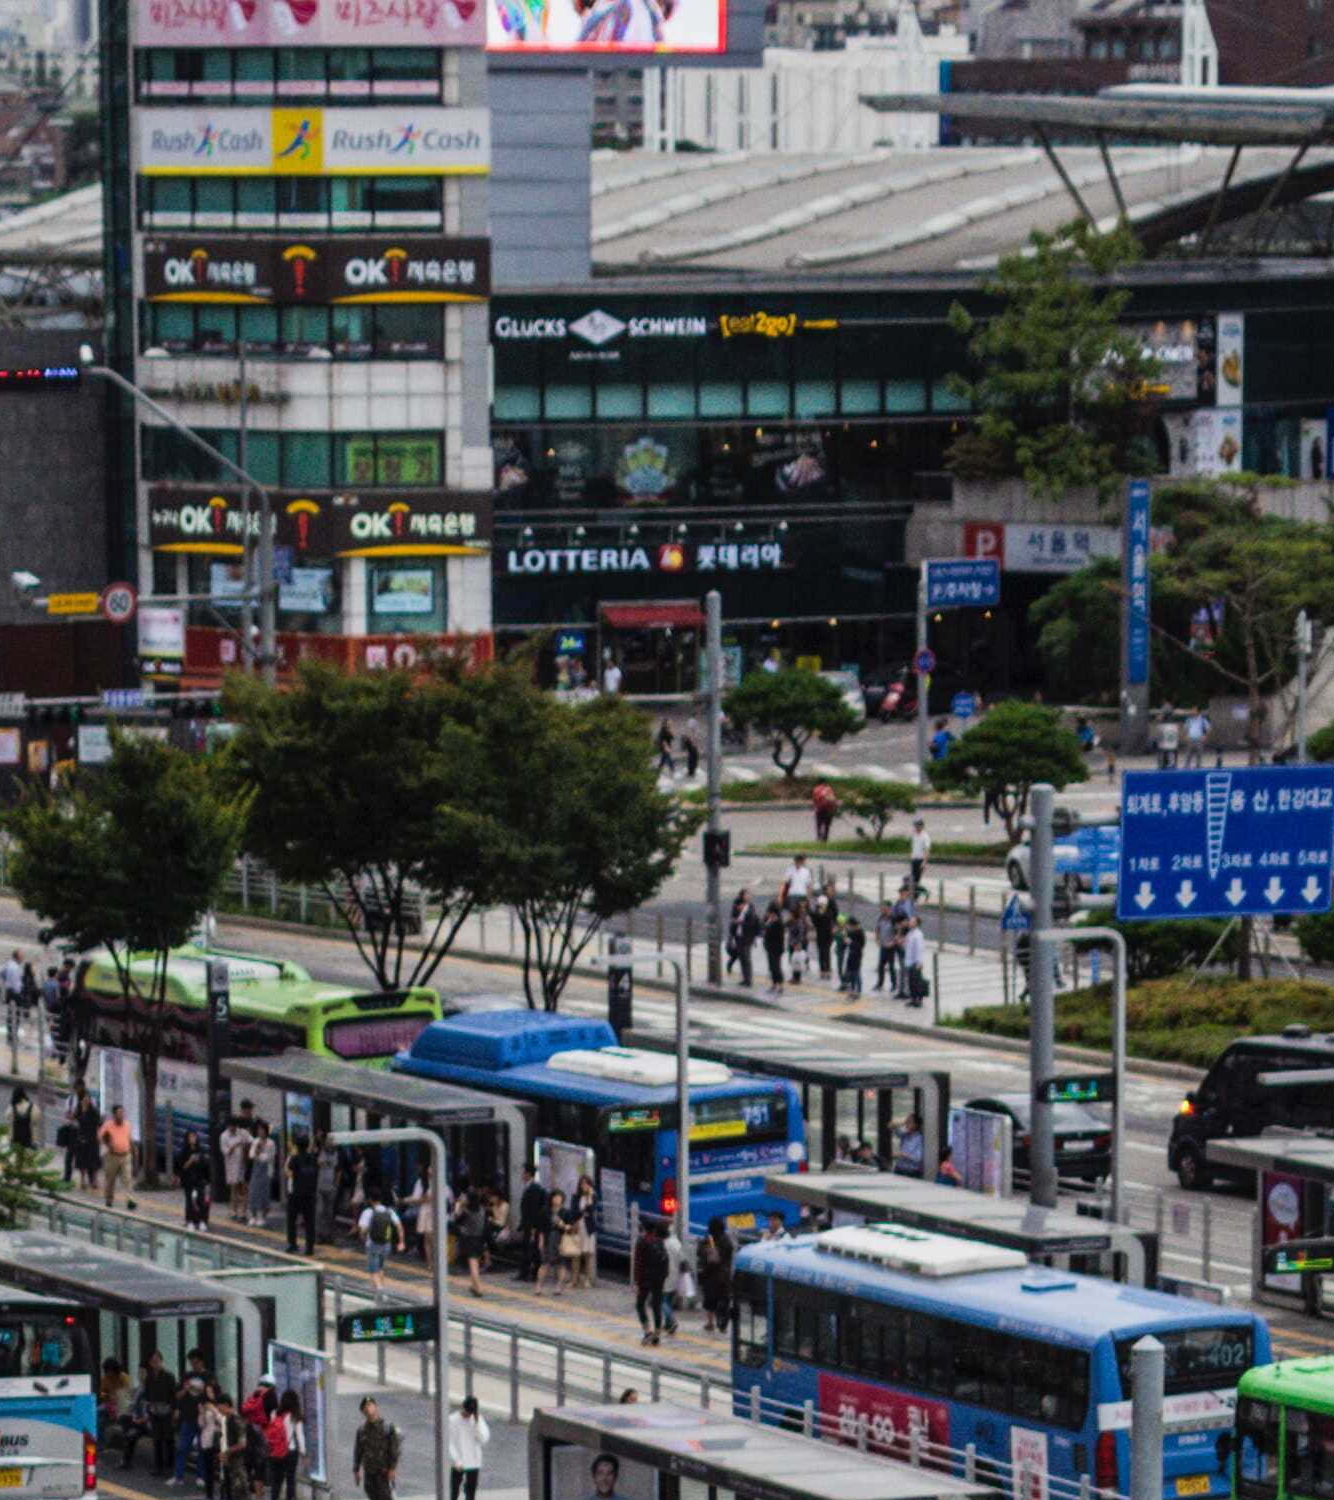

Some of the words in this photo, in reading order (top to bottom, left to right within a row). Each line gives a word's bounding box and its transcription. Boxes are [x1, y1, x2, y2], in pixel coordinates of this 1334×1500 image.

[151, 129, 195, 151] Rush
[218, 128, 264, 151] Cash
[332, 129, 393, 151] Rush
[422, 128, 481, 151] Cash
[163, 257, 196, 286] OK
[344, 258, 388, 286] OK
[627, 316, 707, 338] SCHWEIN
[350, 512, 393, 539] OK
[1028, 529, 1089, 554] 서울역
[508, 547, 650, 573] LOTTERIA
[696, 541, 783, 572] 롯데리아
[110, 592, 128, 612] 60
[1129, 856, 1161, 872] 1차로
[1171, 855, 1203, 871] 2차로
[1221, 853, 1253, 869] 3차로
[1259, 851, 1290, 867] 4차로
[215, 997, 227, 1018] 5
